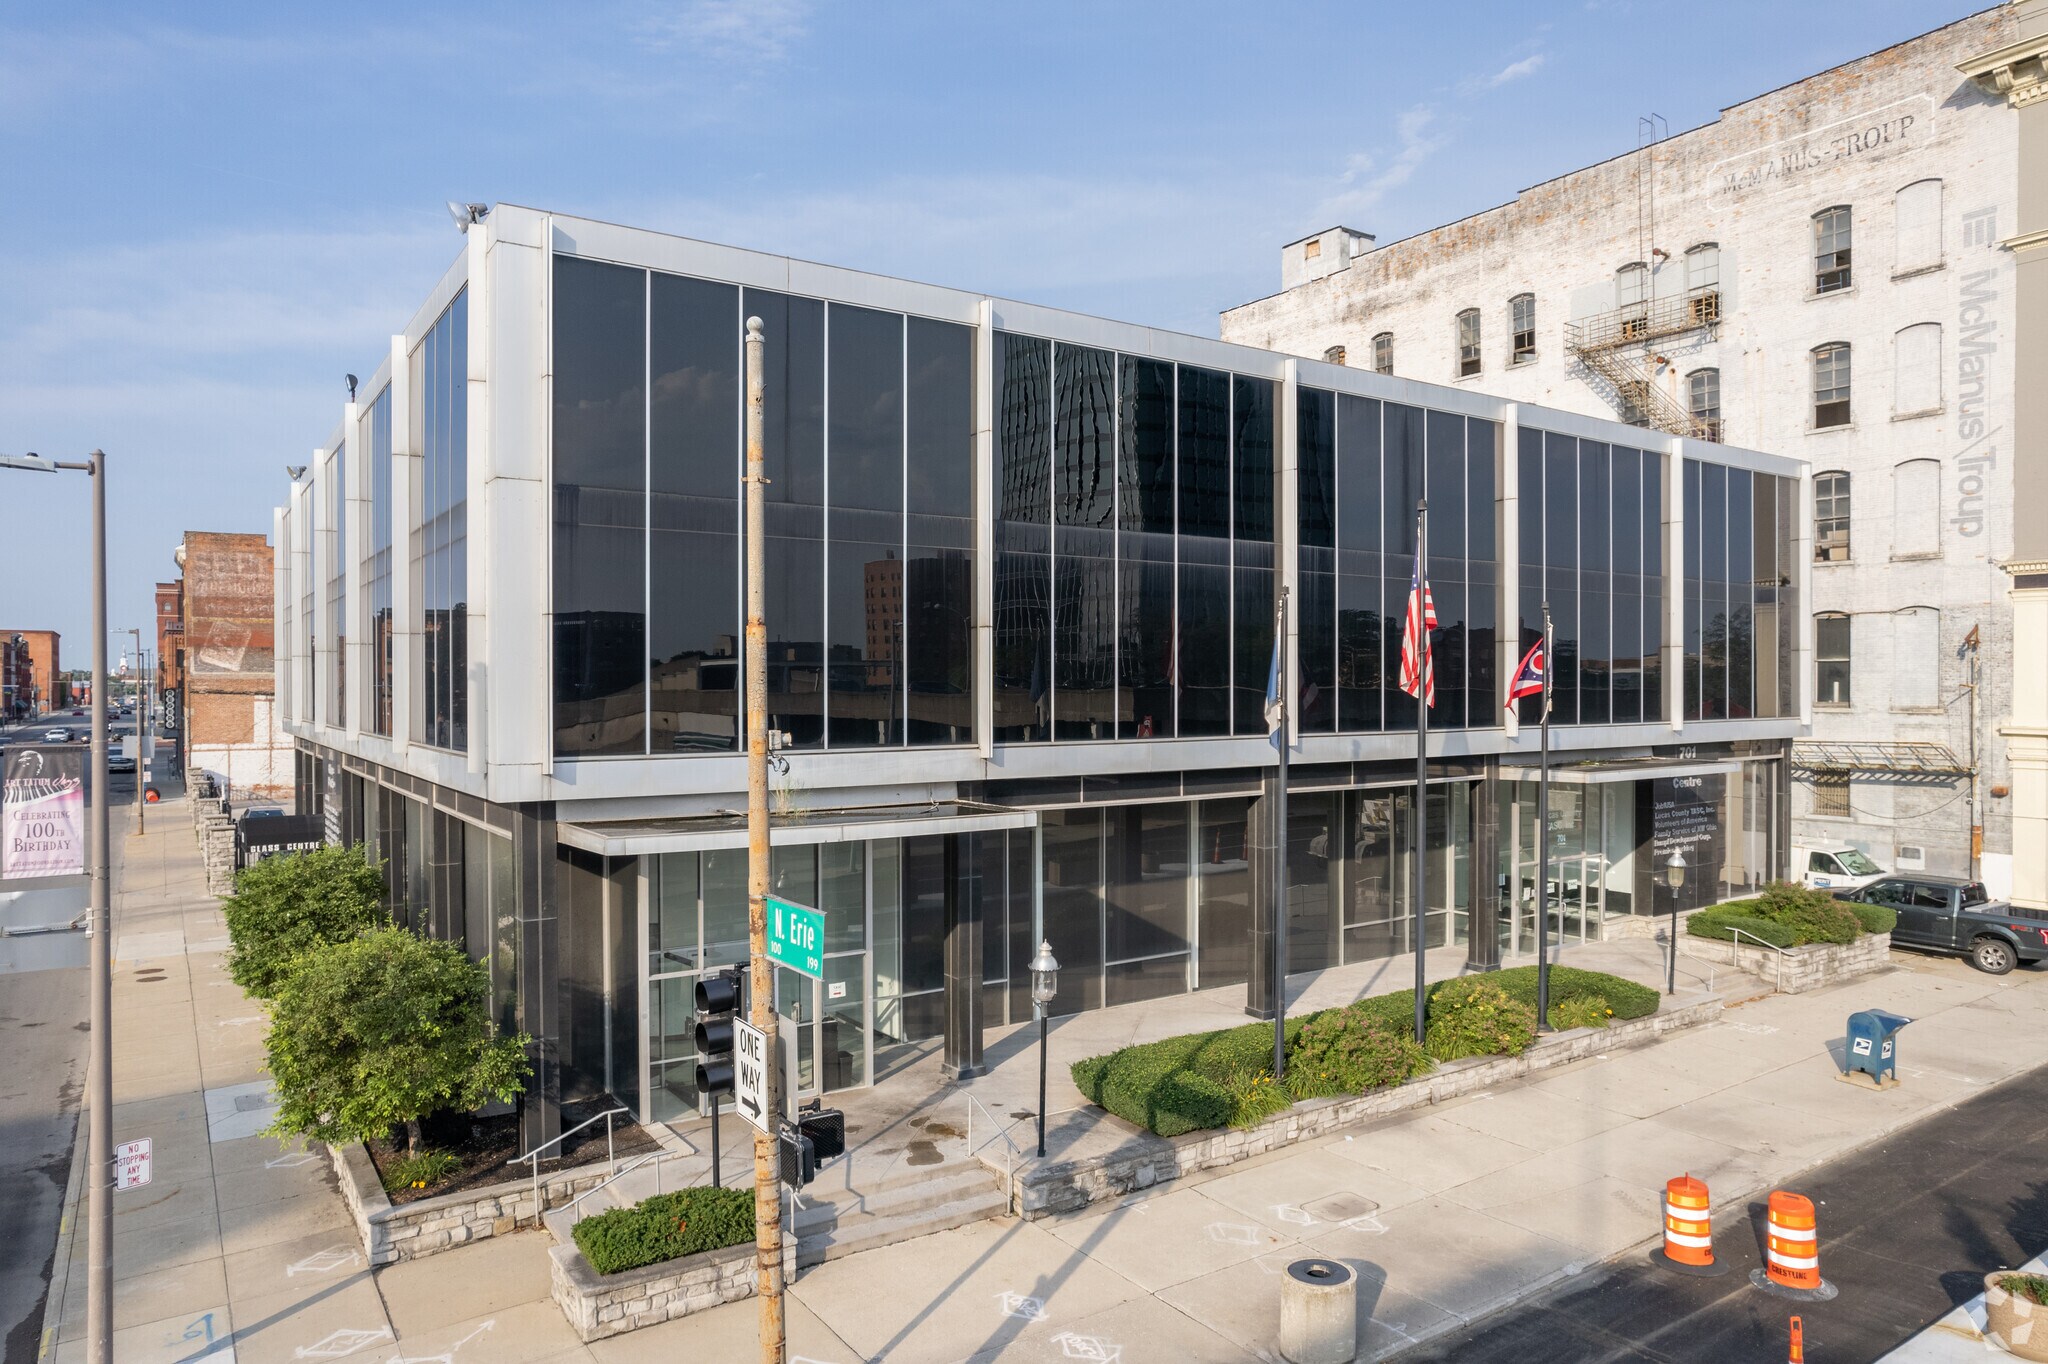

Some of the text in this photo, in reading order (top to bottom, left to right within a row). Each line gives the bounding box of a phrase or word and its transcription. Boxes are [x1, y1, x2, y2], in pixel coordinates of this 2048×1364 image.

[1680, 746, 1697, 759] 701
[3, 772, 81, 790] ART TATUM Jazz
[1673, 777, 1702, 789] Centre
[13, 810, 71, 822] CELEBRATING
[1655, 811, 1670, 820] Lucas
[1671, 809, 1689, 817] County
[1655, 819, 1680, 829] Volunteers
[1686, 816, 1707, 825] America
[1654, 829, 1671, 838] Family
[13, 837, 72, 853] BIRTHDAY
[250, 841, 320, 853] GLASS CENTRE
[774, 907, 815, 951] N. Erie
[770, 940, 782, 956] 100
[806, 955, 819, 971] 199
[739, 1028, 761, 1063] ONE
[740, 1060, 761, 1096] WAY
[128, 1144, 139, 1154] NO
[119, 1152, 149, 1167] STOPPING
[127, 1164, 141, 1176] ANY
[127, 1175, 141, 1186] TIME
[1771, 1264, 1808, 1280] CRESTLINE
